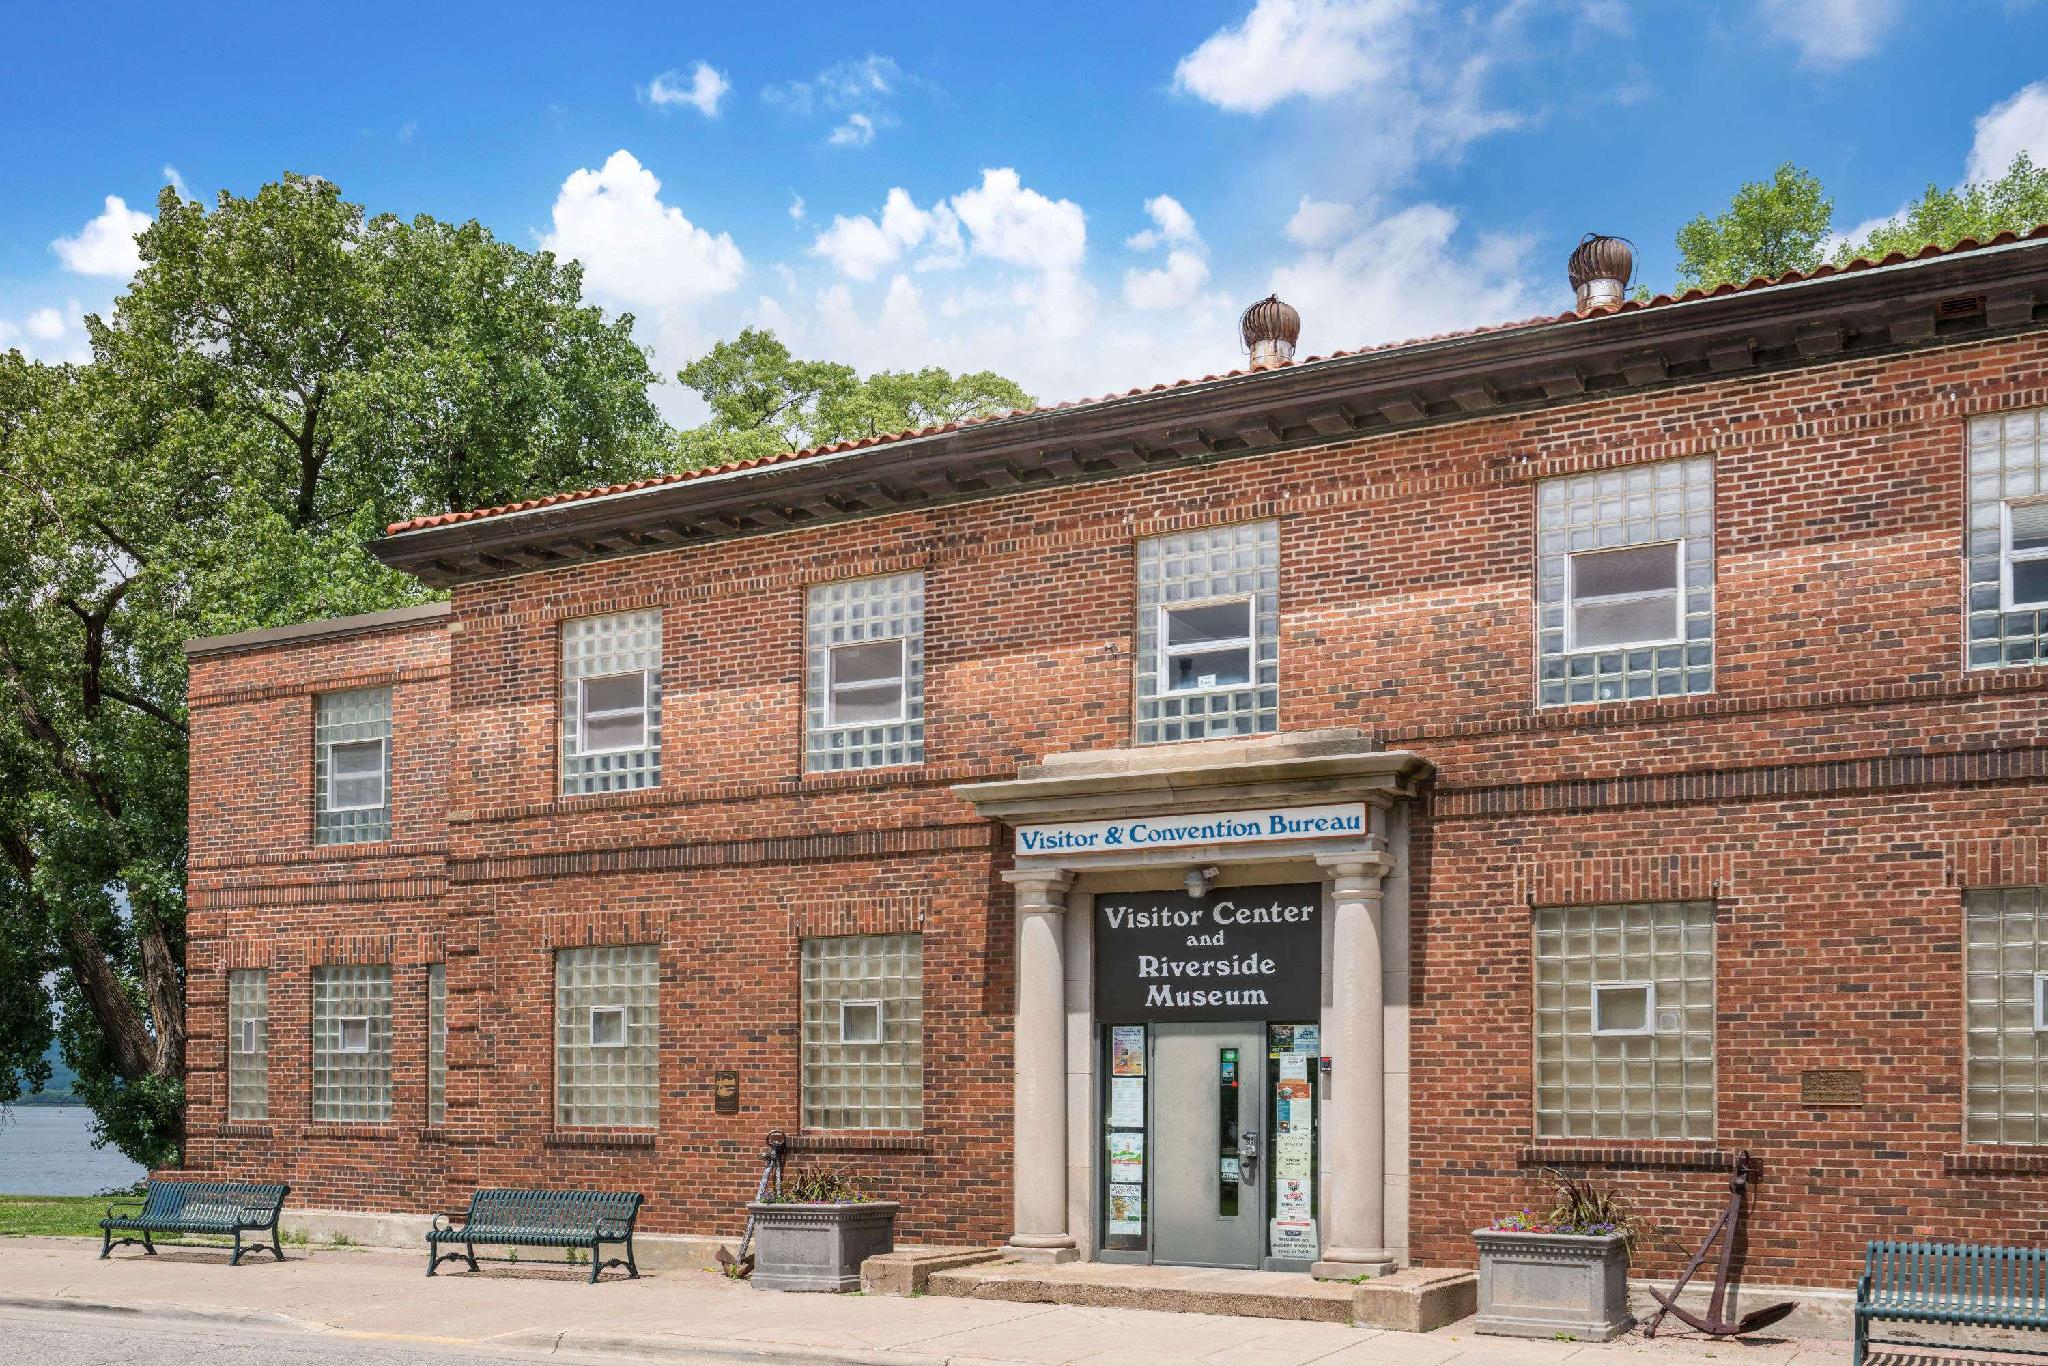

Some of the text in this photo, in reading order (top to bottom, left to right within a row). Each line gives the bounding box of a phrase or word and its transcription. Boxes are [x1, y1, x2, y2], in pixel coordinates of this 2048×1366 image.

[1021, 815, 1361, 849] Visitor & Convention Bureau
[1104, 901, 1314, 928] Visitor Center
[1186, 930, 1225, 946] and
[1138, 953, 1276, 977] Riverside
[1144, 985, 1268, 1006] Museum
